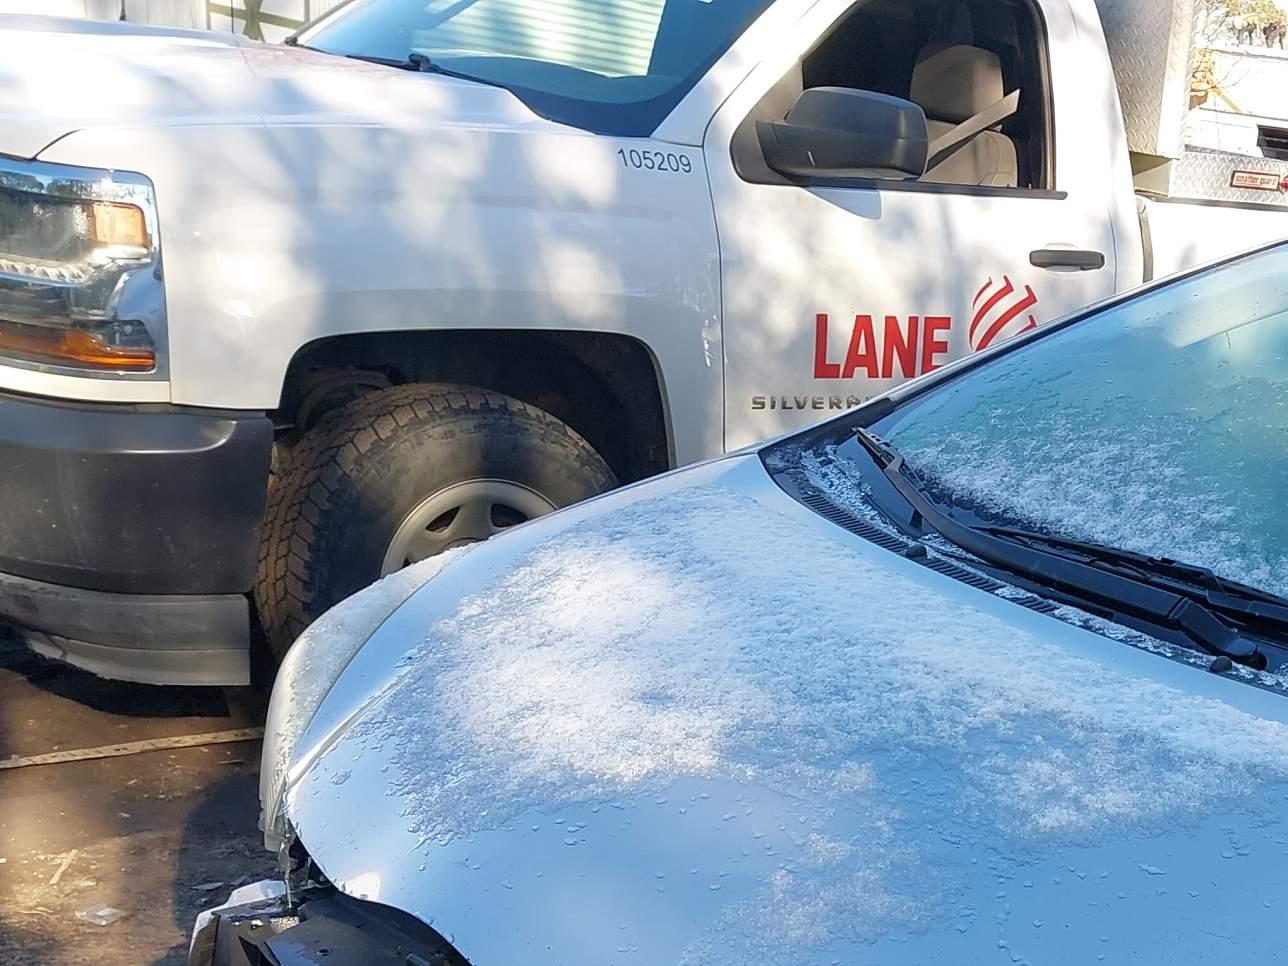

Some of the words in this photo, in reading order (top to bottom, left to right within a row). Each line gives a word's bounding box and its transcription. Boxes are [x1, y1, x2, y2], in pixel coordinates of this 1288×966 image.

[617, 148, 692, 173] 105209
[814, 313, 952, 379] LANE
[751, 393, 872, 410] SILVERA
